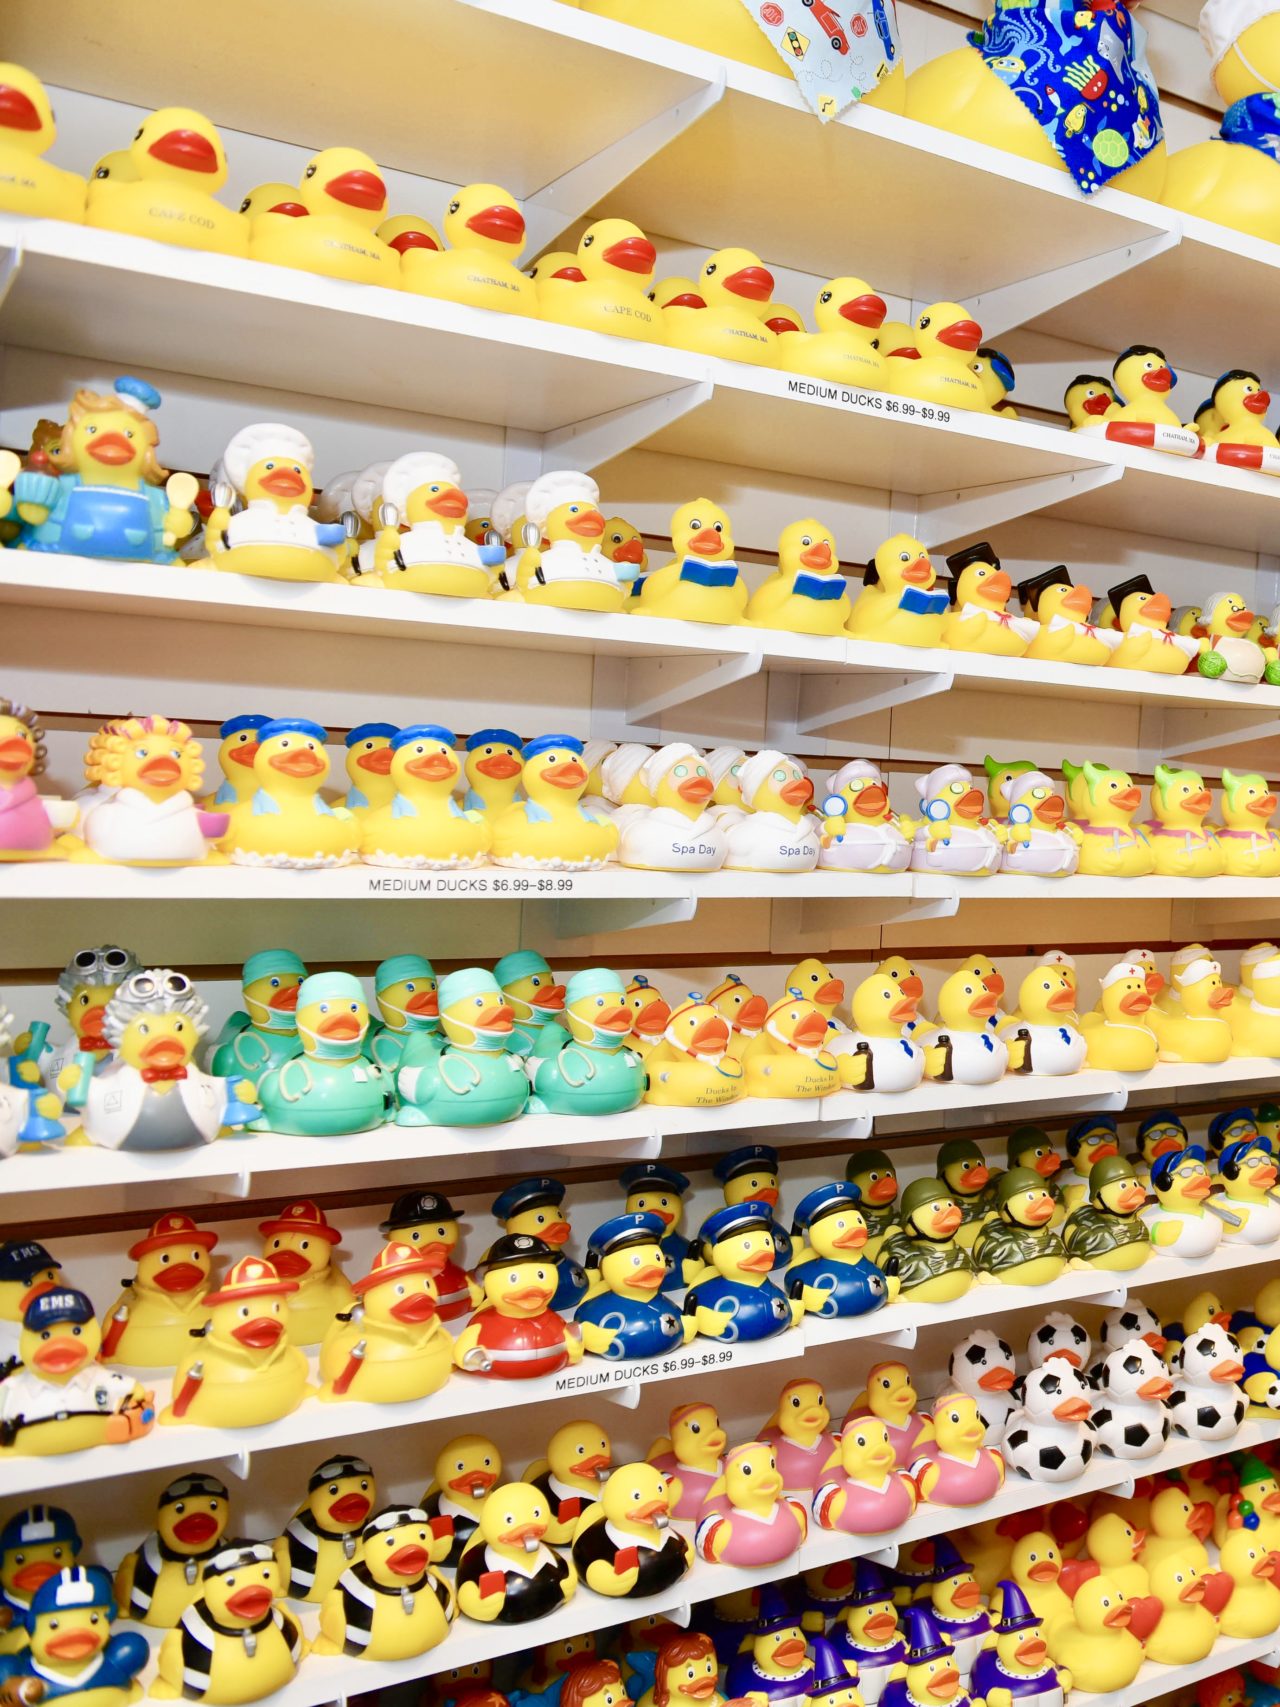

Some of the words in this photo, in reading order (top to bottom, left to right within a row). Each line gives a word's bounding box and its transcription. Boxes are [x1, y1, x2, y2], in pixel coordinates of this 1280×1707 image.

[188, 213, 216, 230] COD
[603, 304, 633, 317] CAPE
[634, 310, 652, 323] COD
[787, 380, 838, 401] MEDIUM
[841, 391, 882, 409] DUCKS
[671, 842, 696, 856] Spa
[698, 843, 717, 856] Day
[779, 845, 801, 857] Spa
[802, 845, 816, 857] Day
[368, 879, 431, 891] MEDIUM
[436, 879, 488, 891] DUCKS
[705, 1086, 730, 1095] Ducks
[795, 1086, 812, 1094] The
[696, 1096, 713, 1104] The
[754, 1147, 763, 1155] P
[646, 1164, 656, 1173] P
[541, 1179, 550, 1187] P
[835, 1183, 845, 1194] P
[749, 1204, 758, 1214] P
[634, 1214, 645, 1225] P
[11, 1245, 41, 1262] EMS
[40, 1294, 75, 1312] EMS
[555, 1372, 610, 1391] MEDIUM
[614, 1364, 659, 1381] DUCKS
